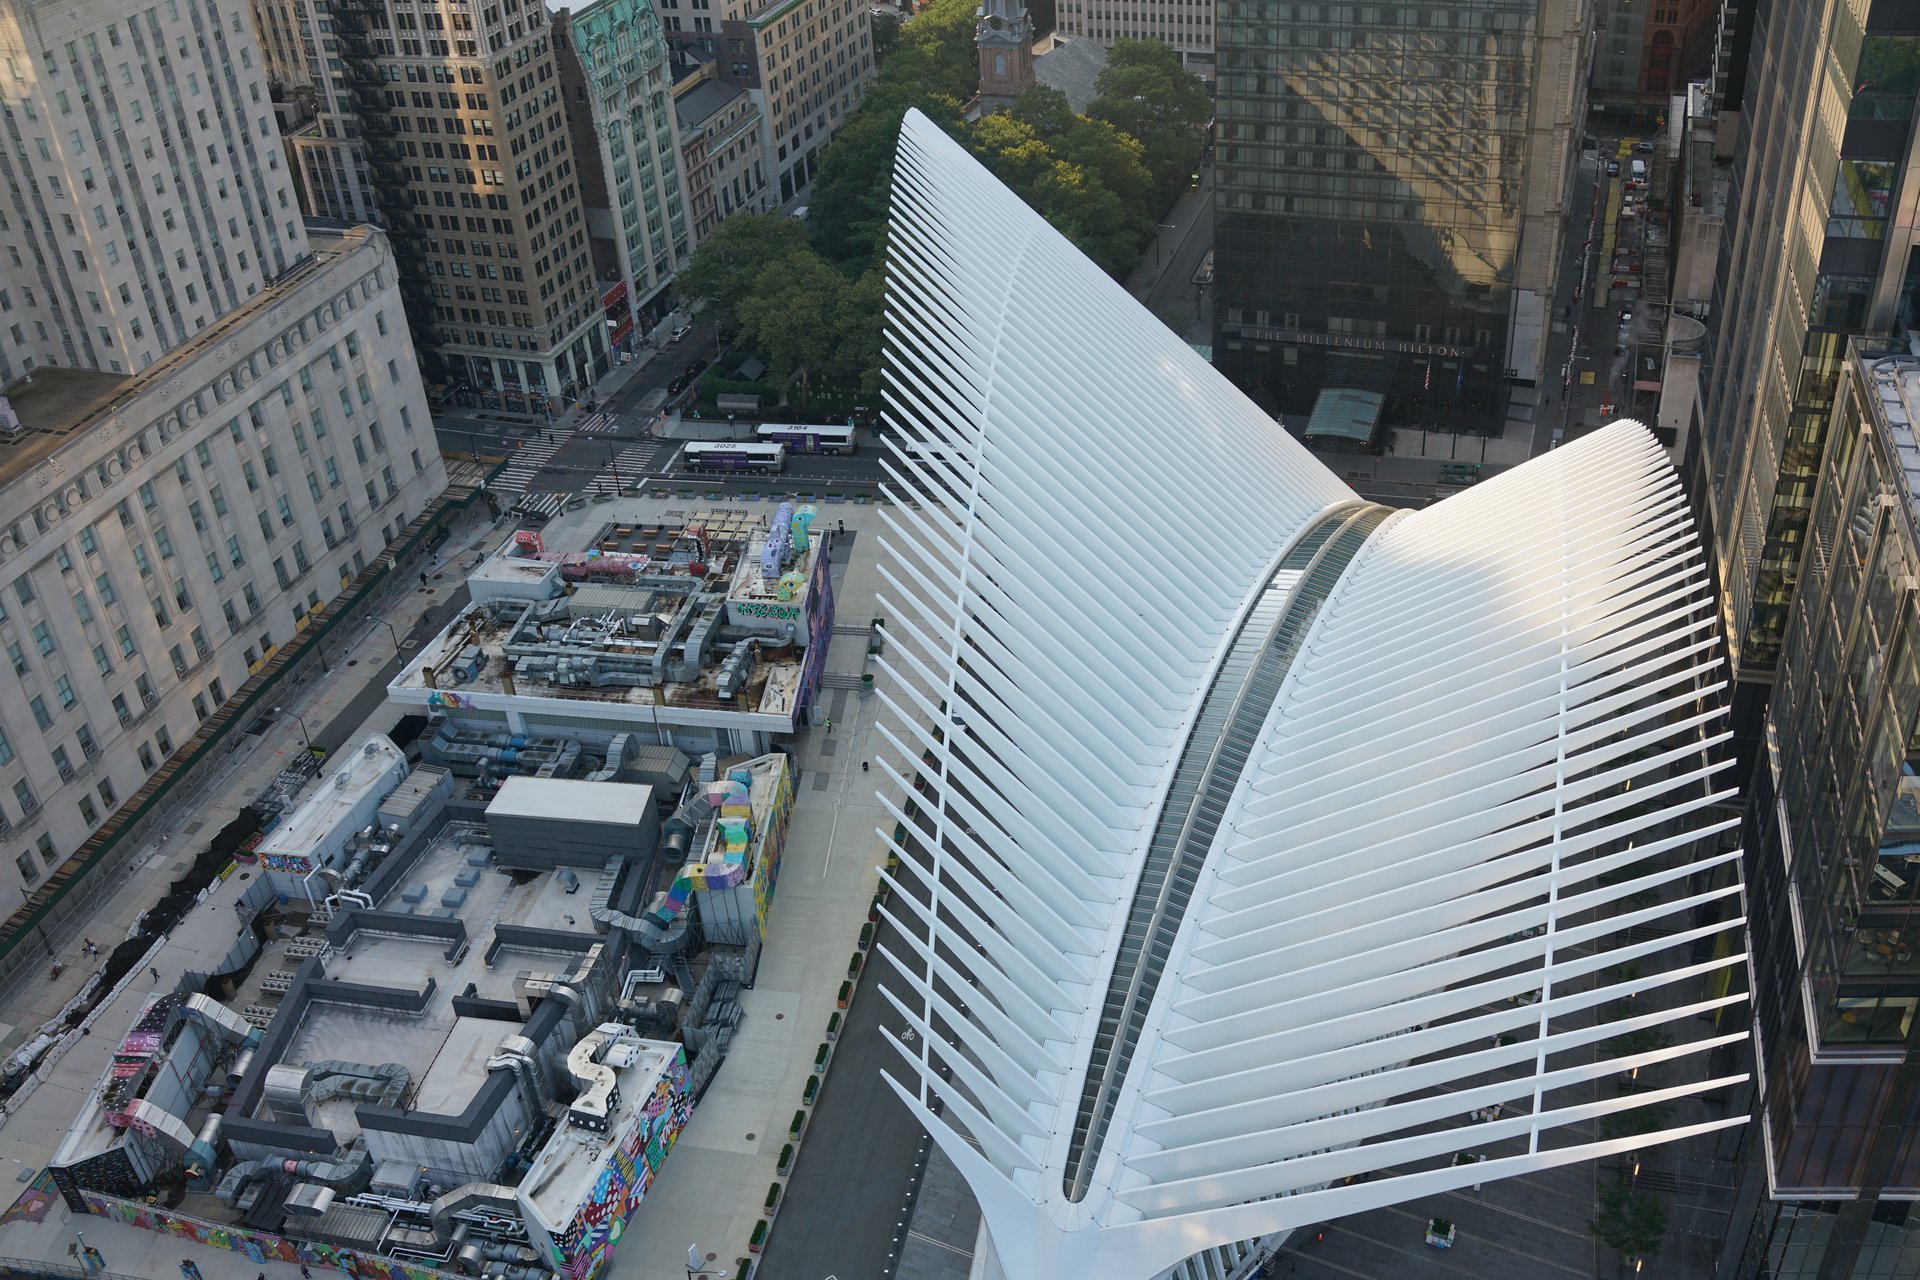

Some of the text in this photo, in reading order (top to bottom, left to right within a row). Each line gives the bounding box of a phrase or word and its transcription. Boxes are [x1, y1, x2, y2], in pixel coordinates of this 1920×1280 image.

[1255, 330, 1459, 357] THE MILLENIUM HILTON
